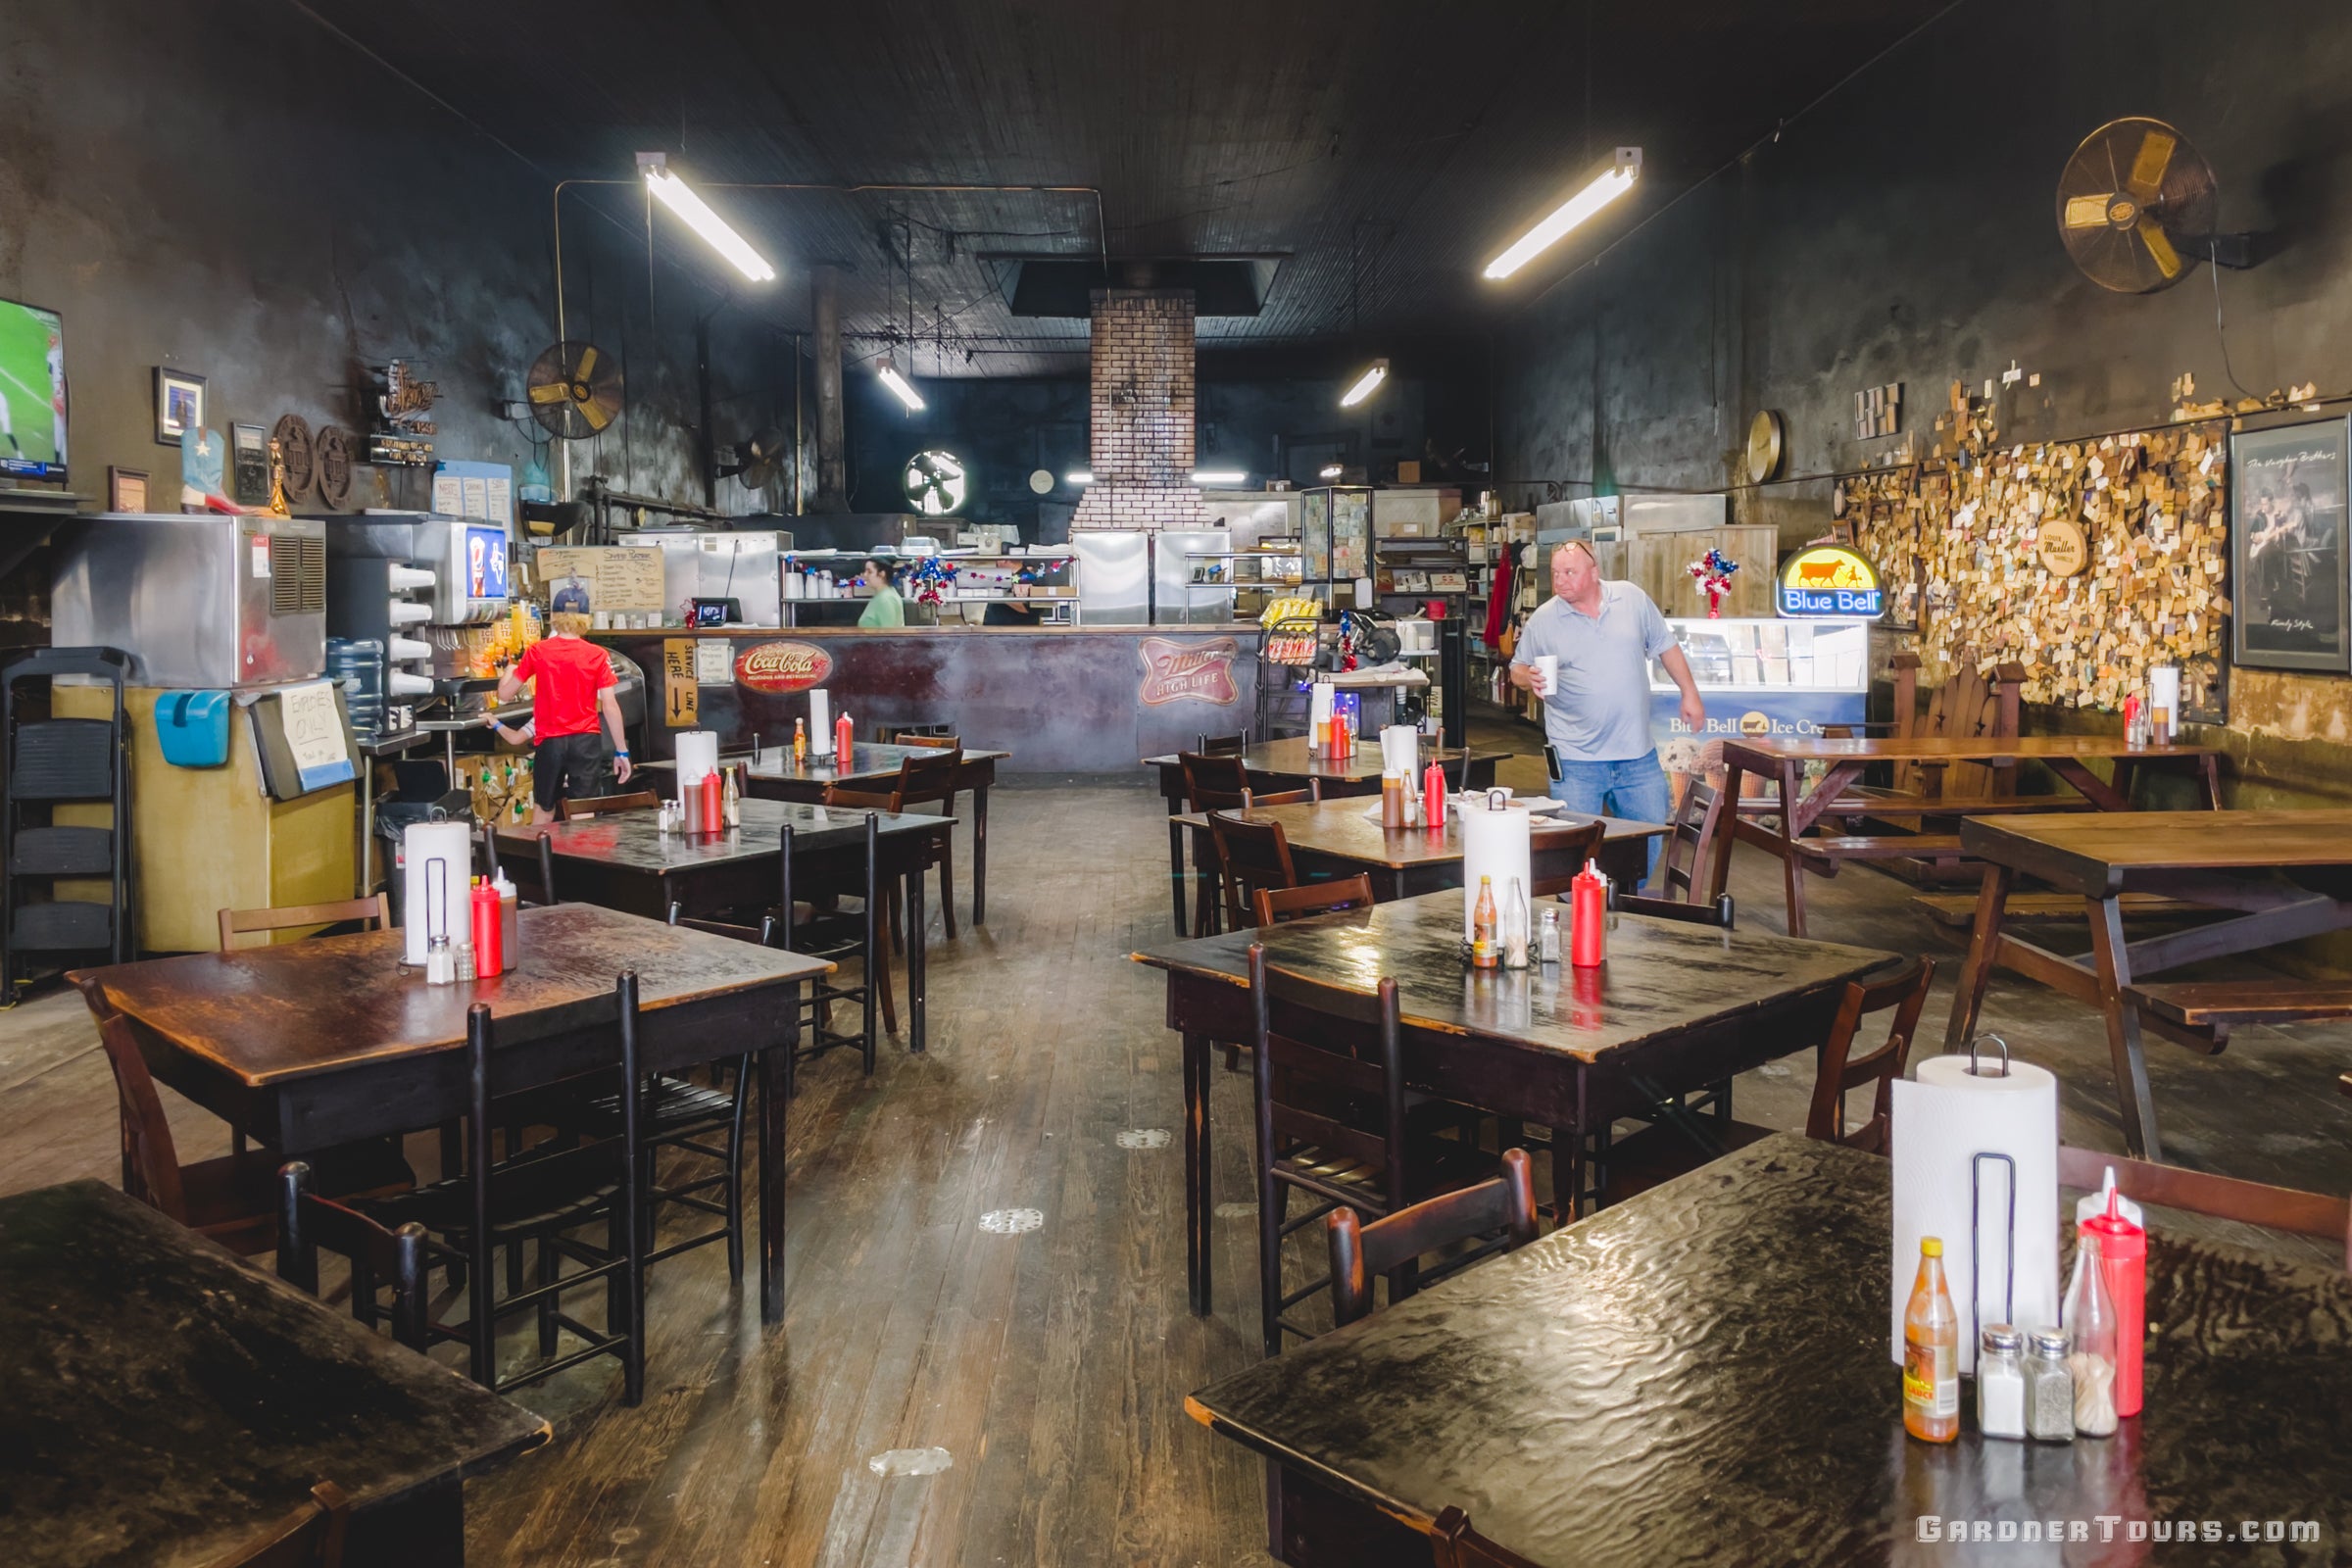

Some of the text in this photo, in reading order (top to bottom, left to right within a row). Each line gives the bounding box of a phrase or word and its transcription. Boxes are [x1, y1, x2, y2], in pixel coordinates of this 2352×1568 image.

[2298, 450, 2336, 463] Brothers
[1784, 590, 1877, 611] Blue Bell
[666, 652, 684, 679] HERE
[685, 645, 694, 679] SERVICE
[1156, 651, 1219, 678] Miller
[1156, 672, 1219, 696] HIGH LIFE
[1705, 717, 1738, 733] Bell
[1772, 718, 1793, 734] Ice
[1796, 718, 1826, 735] Cre
